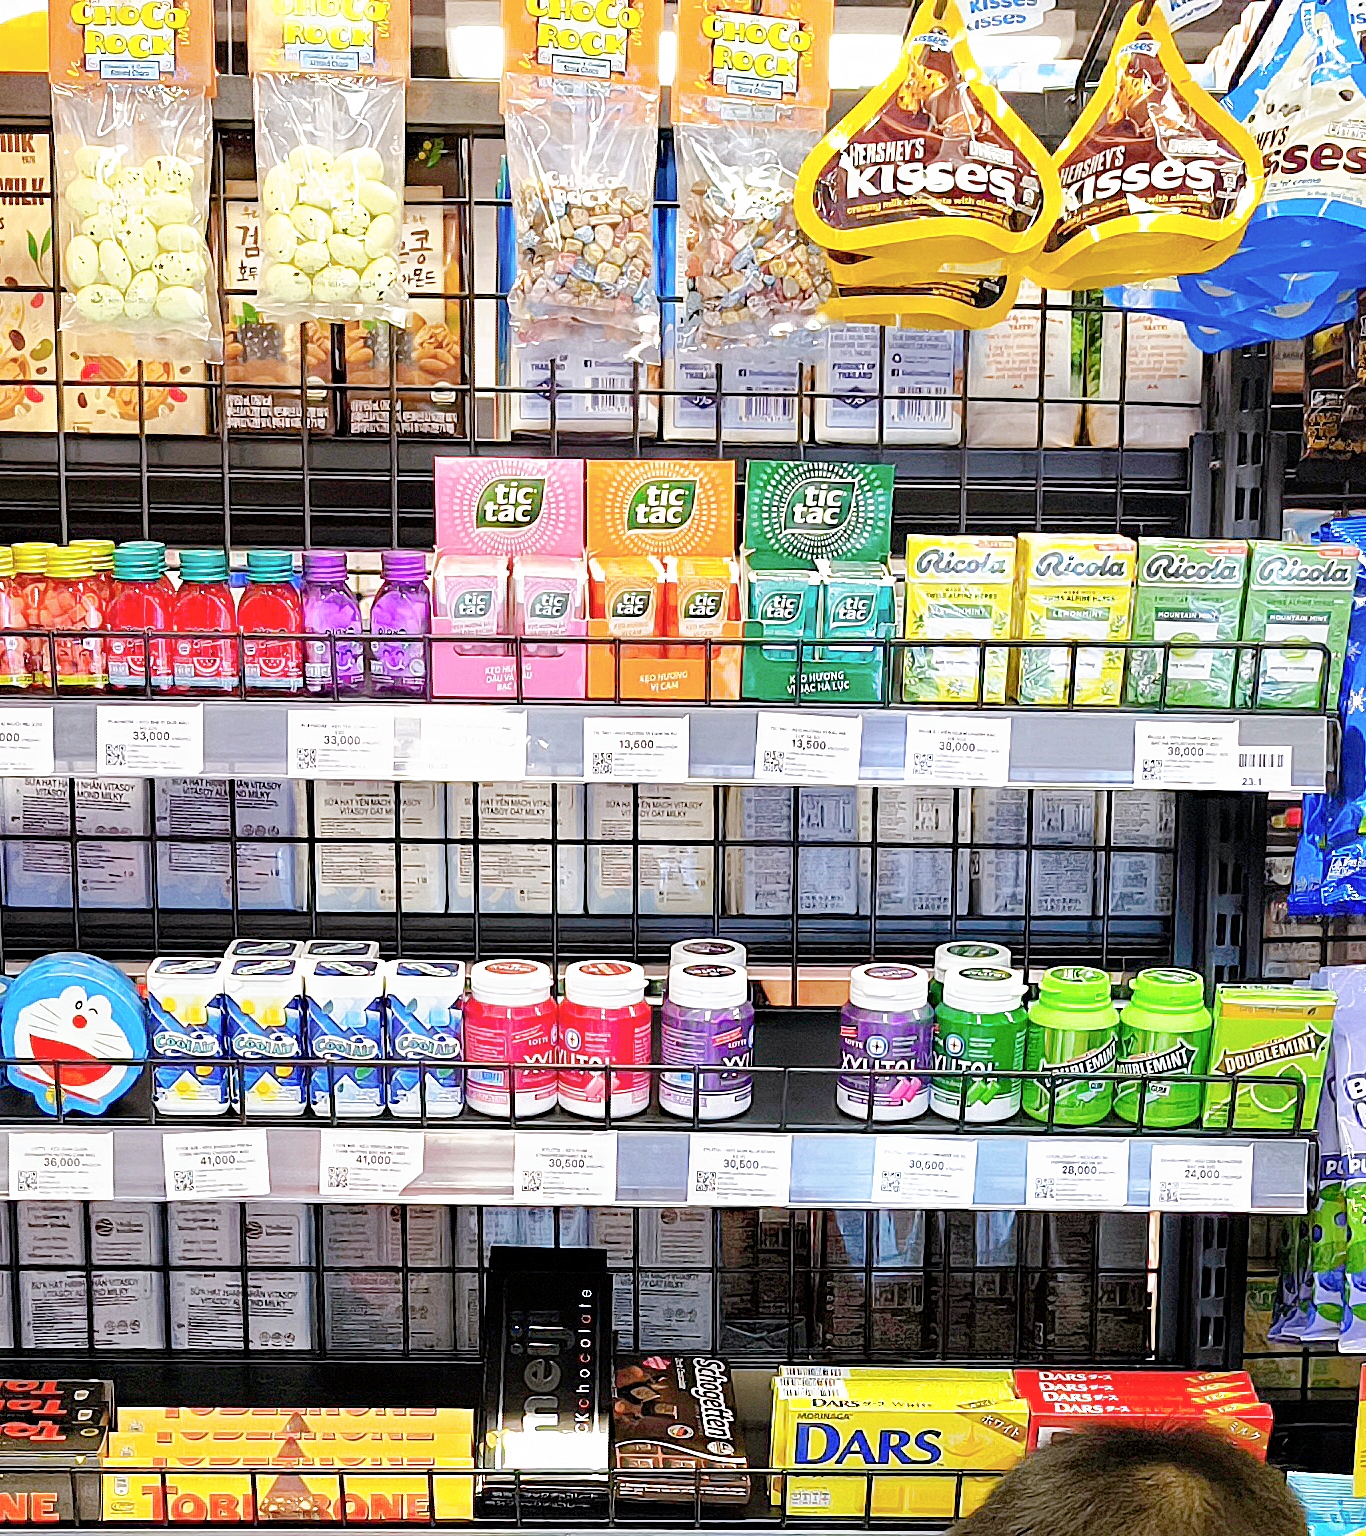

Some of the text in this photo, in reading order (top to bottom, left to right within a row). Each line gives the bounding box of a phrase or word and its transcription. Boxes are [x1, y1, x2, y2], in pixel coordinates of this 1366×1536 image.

[529, 0, 639, 31] CHOCO
[703, 15, 812, 45] CHOCO
[85, 32, 174, 61] ROCK
[539, 25, 625, 60] ROCK
[711, 45, 799, 78] ROCK
[495, 483, 538, 504] tic
[647, 483, 690, 504] tic
[804, 487, 848, 508] tic
[482, 503, 534, 525] tac
[636, 503, 688, 525] tac
[792, 505, 846, 528] tac
[915, 550, 1007, 582] Ricola
[1035, 552, 1127, 583] Ricola
[1146, 555, 1239, 585] Ricola
[1256, 558, 1351, 586] Ricola
[132, 731, 170, 741] 33,000
[1222, 1028, 1321, 1075] DOUBLEMINT
[44, 1157, 81, 1167] 36,000
[200, 1155, 237, 1165] 41,000
[356, 1155, 392, 1165] 41,000
[1184, 1169, 1221, 1180] 24,000
[1054, 1403, 1104, 1413] DARS
[793, 1424, 942, 1465] DARS
